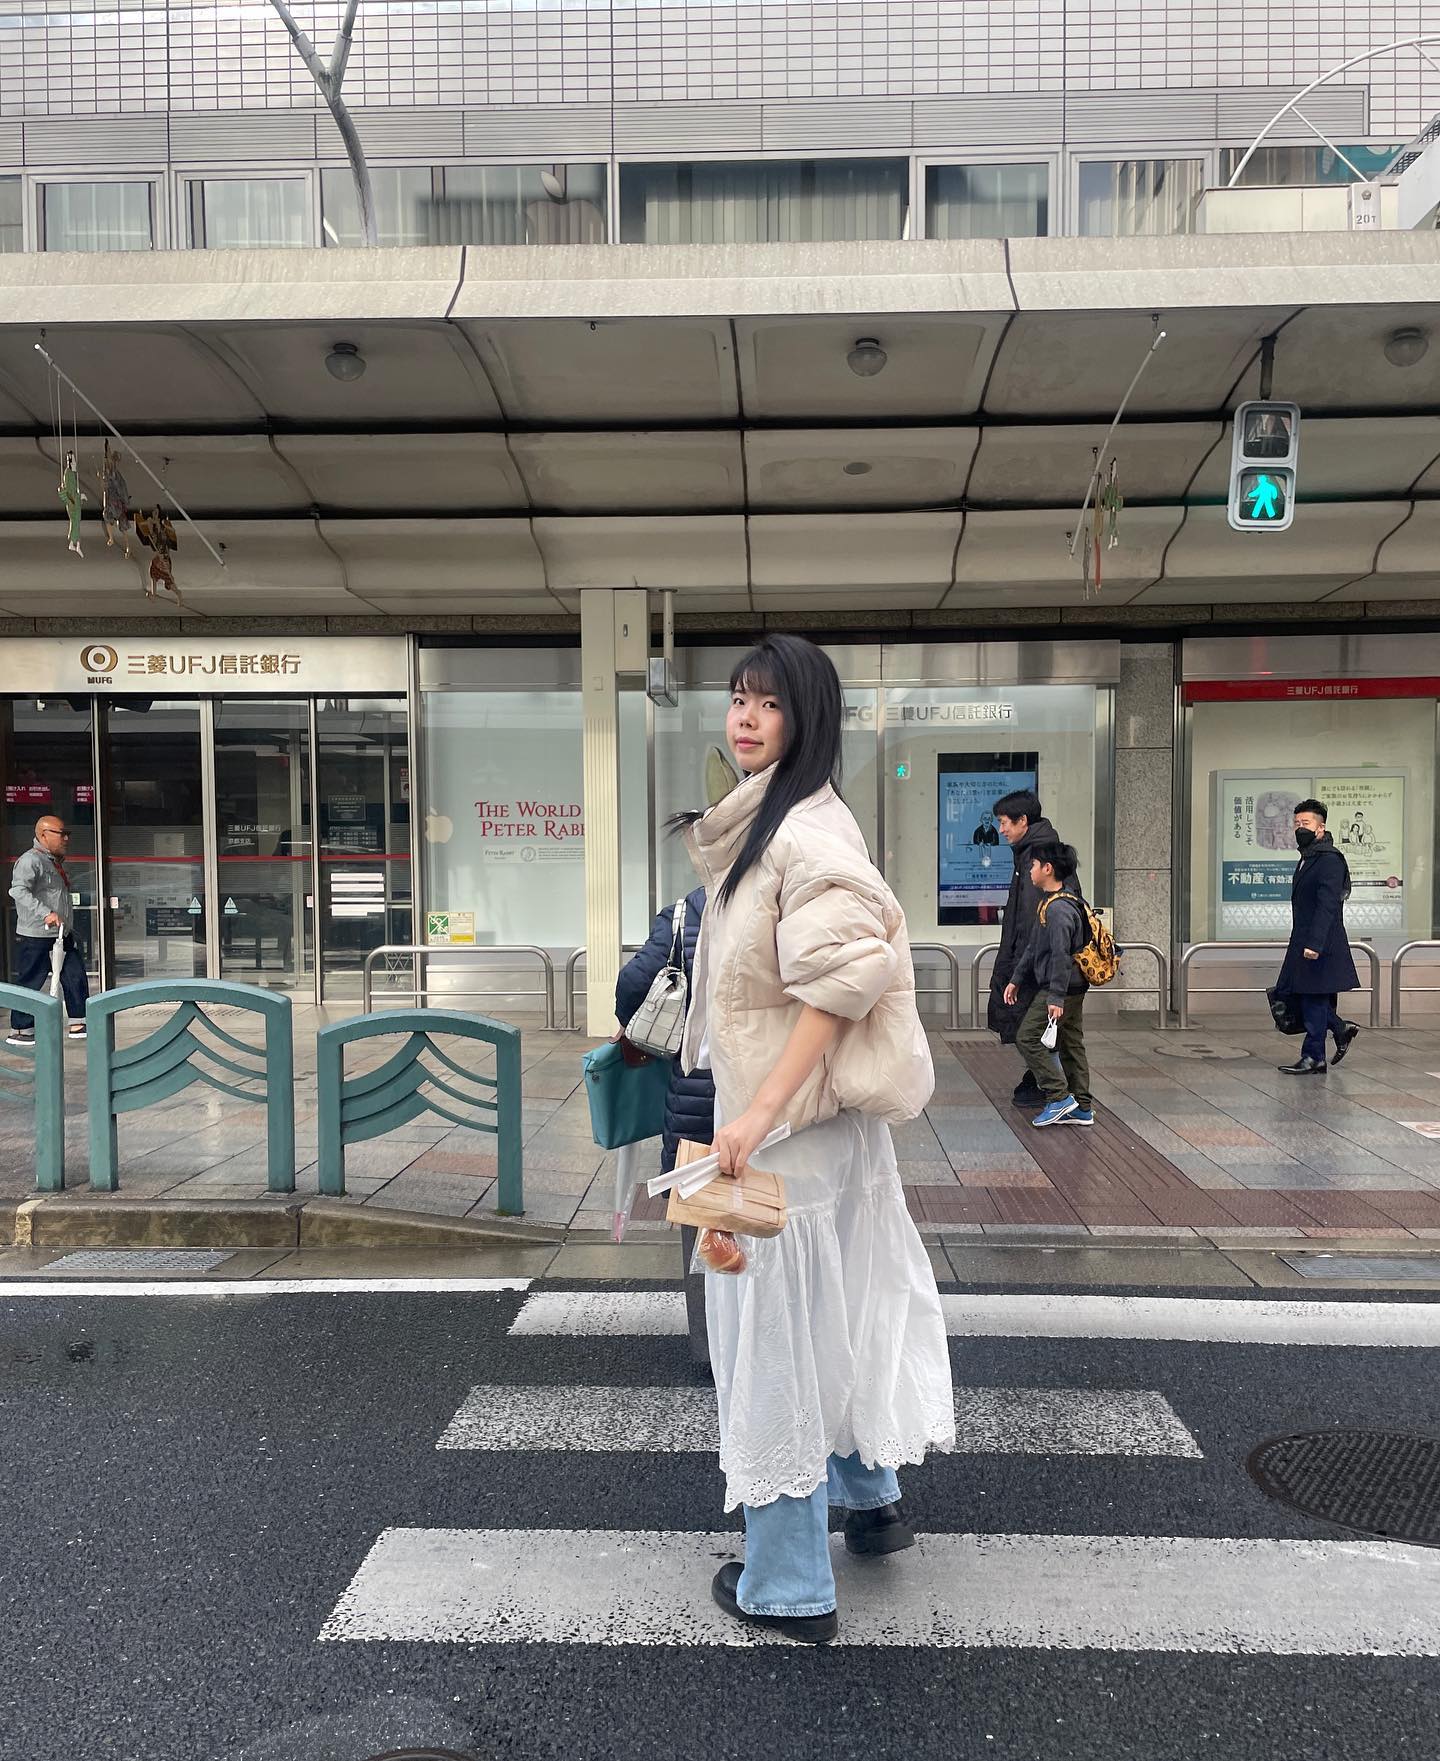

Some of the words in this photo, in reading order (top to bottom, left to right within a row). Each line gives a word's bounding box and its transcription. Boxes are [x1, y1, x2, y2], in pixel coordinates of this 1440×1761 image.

[127, 653, 302, 675] 三菱UFJ信託銀行
[87, 676, 113, 685] MUFG
[886, 703, 1013, 721] 三菱UFJ信託銀行
[474, 801, 510, 818] THE
[516, 801, 582, 818] WORLD
[1233, 796, 1243, 839] 価値がある
[480, 820, 538, 837] PETER
[1245, 796, 1254, 846] 活用してこそ
